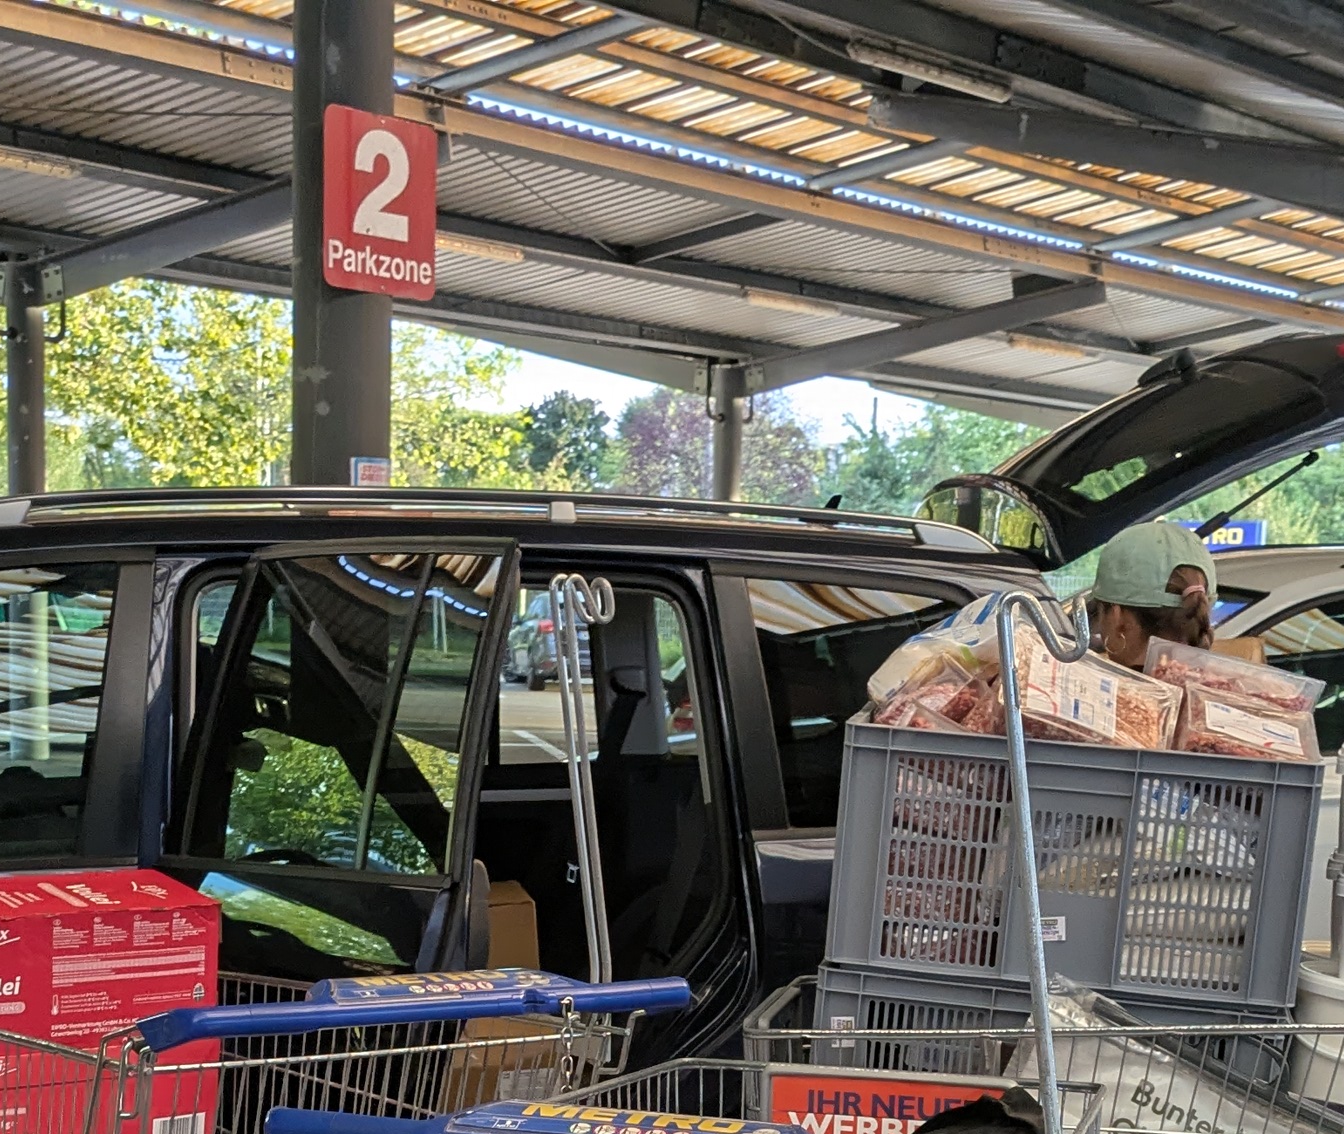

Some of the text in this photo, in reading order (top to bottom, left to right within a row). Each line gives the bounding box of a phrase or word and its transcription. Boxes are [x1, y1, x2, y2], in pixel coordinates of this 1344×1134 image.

[353, 129, 409, 242] 2
[328, 239, 432, 285] Parkzone
[356, 971, 507, 987] METRO
[808, 1089, 863, 1117] IHR
[521, 1104, 746, 1134] METRO
